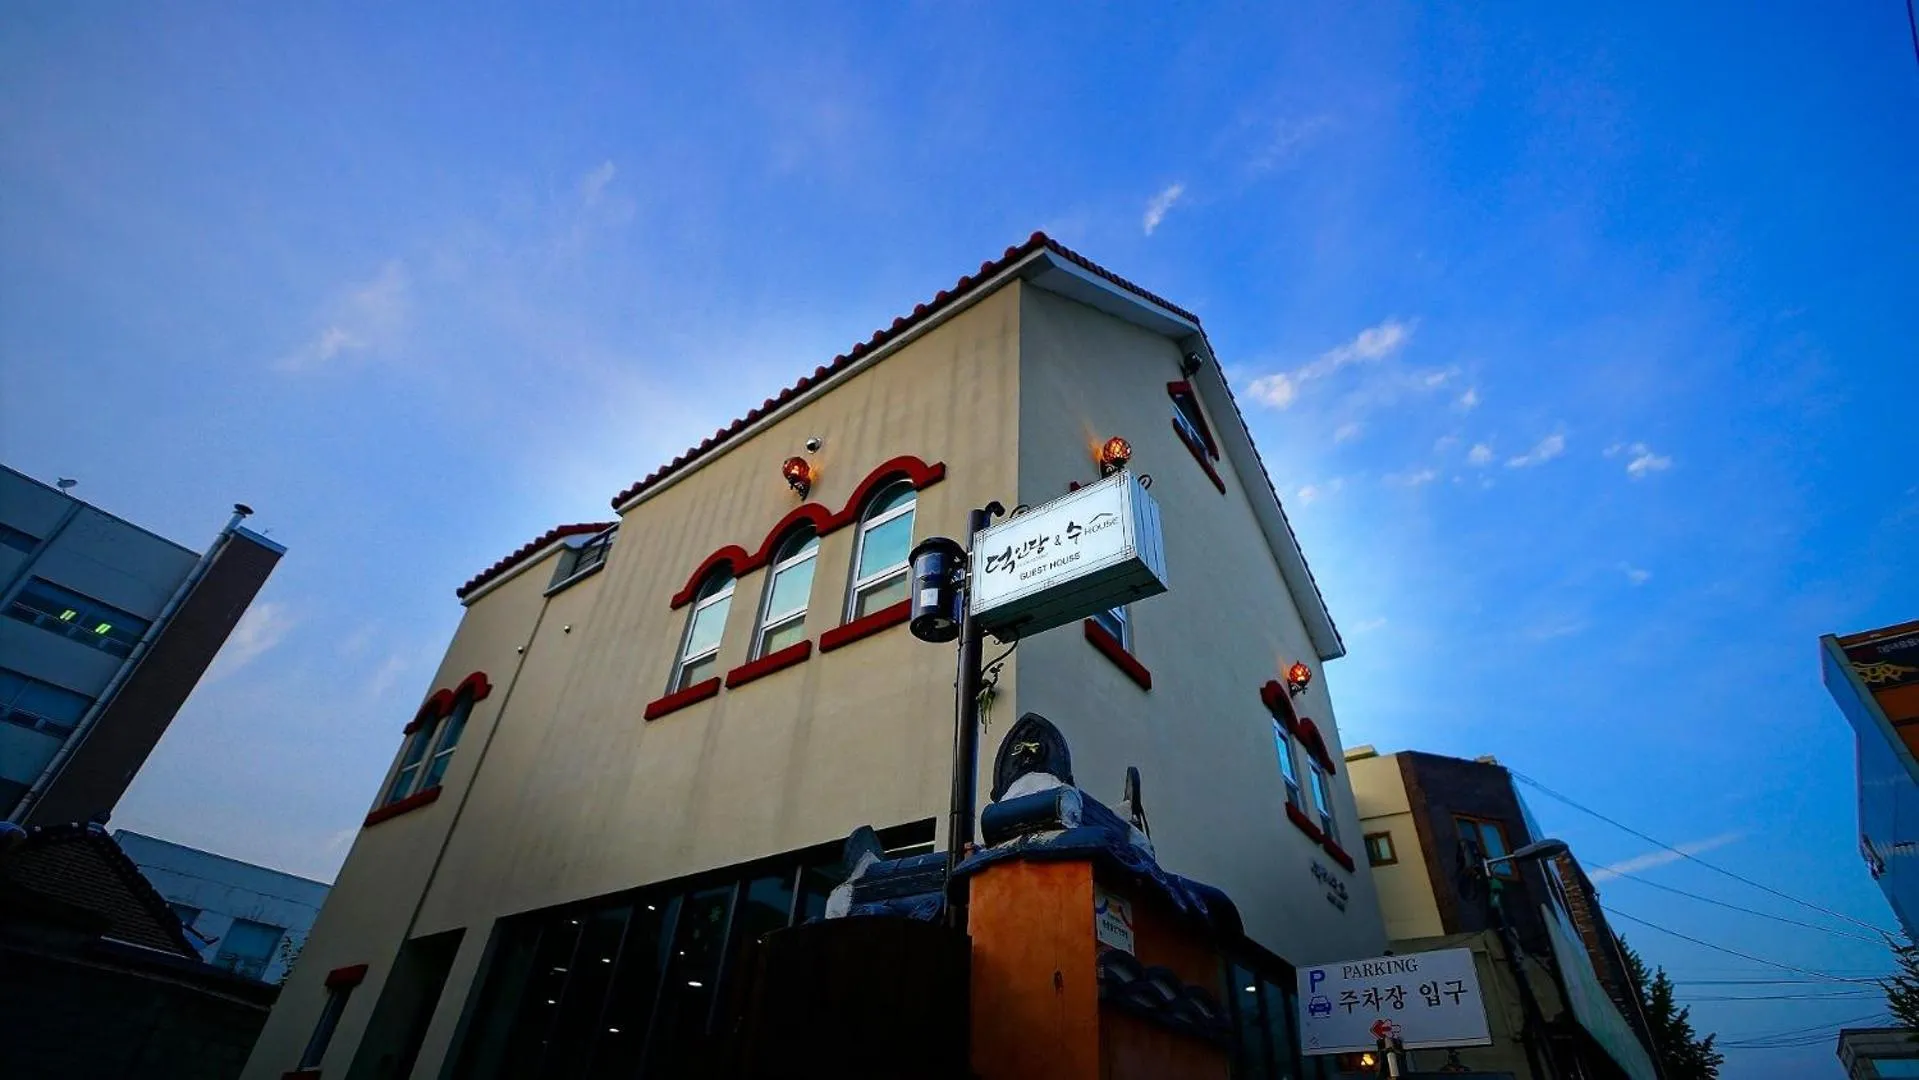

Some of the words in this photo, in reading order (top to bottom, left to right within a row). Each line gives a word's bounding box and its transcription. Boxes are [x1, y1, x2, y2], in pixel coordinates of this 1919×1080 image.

[1054, 535, 1062, 546] &
[1084, 517, 1118, 536] HOUSE
[1020, 564, 1047, 580] GUEST
[1049, 552, 1081, 569] HOUSE
[1343, 958, 1419, 980] PARKING
[1339, 985, 1407, 1014] 주차장
[1419, 980, 1468, 1007] 입구
